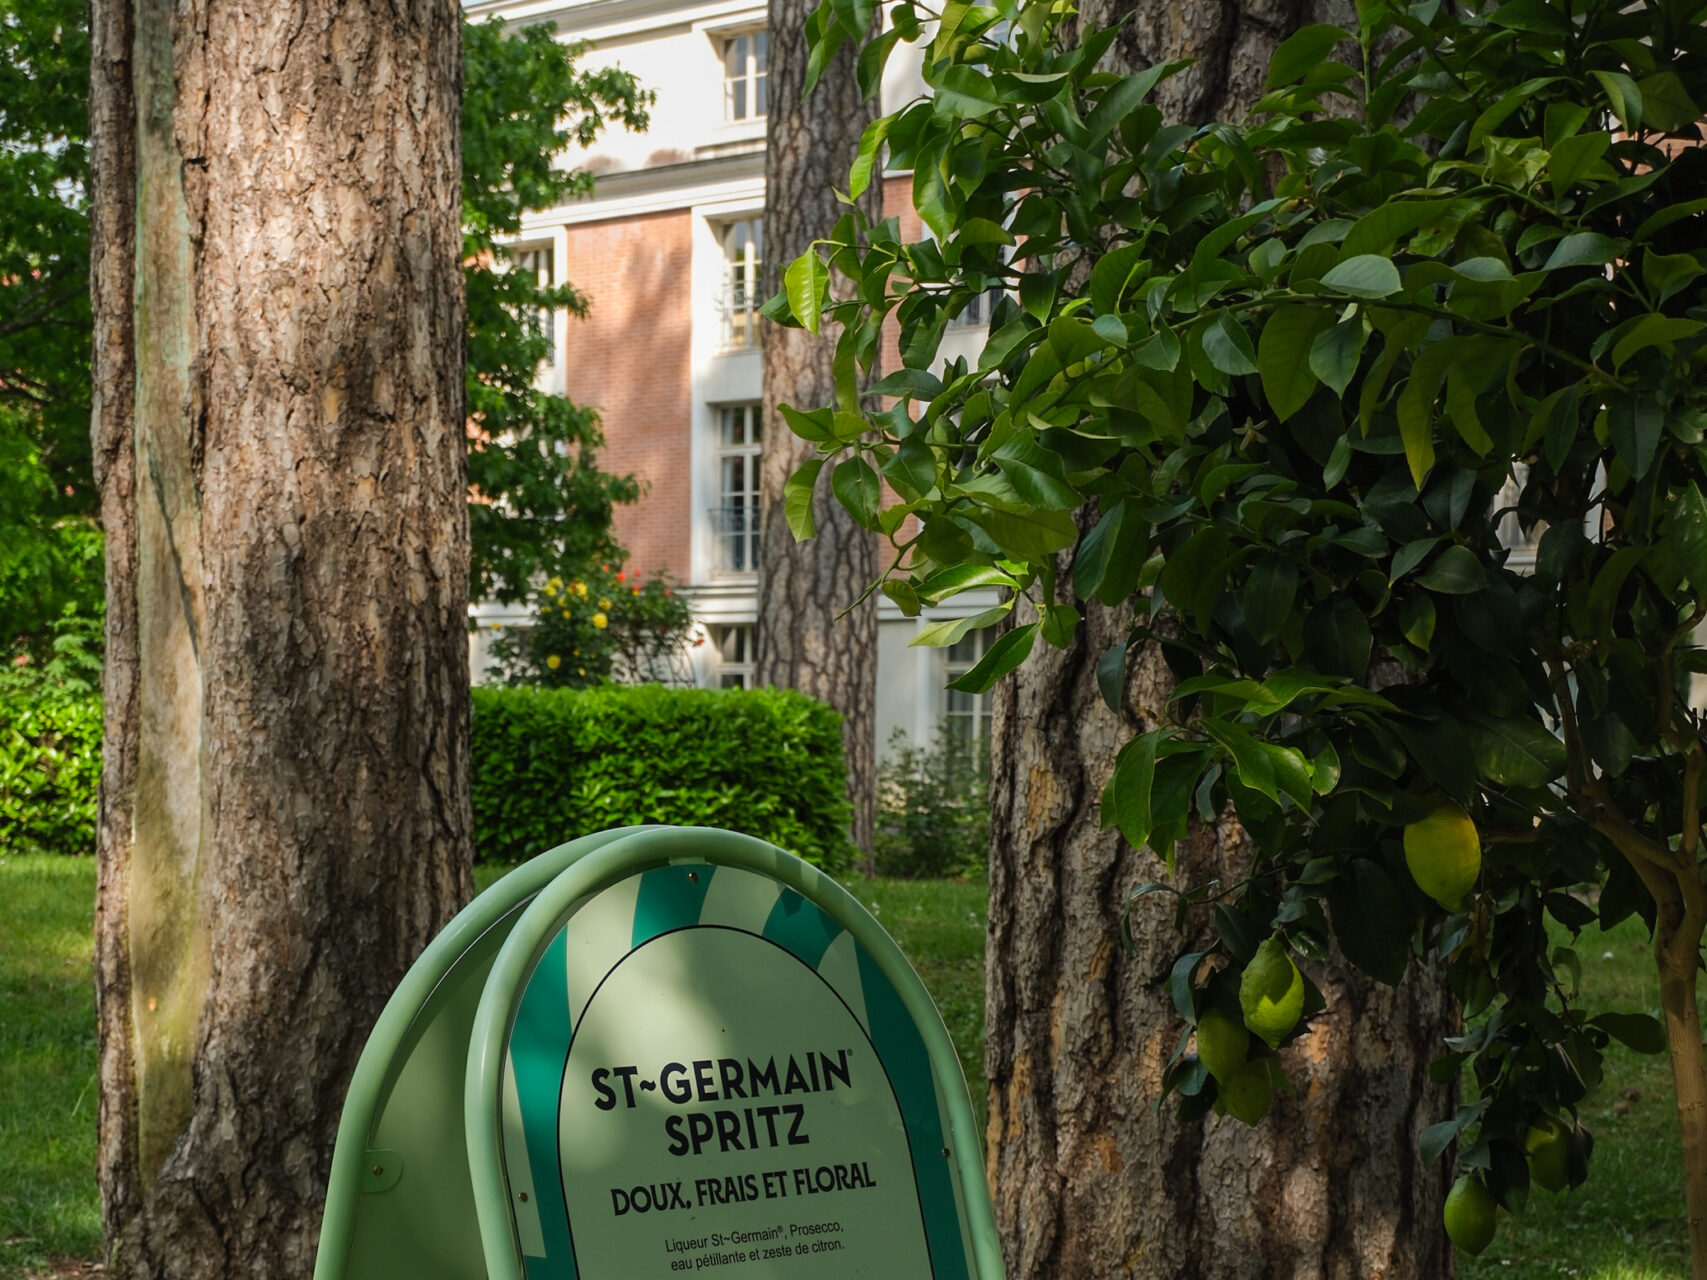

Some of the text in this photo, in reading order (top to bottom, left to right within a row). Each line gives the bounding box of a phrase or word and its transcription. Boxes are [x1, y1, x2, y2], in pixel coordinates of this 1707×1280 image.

[665, 1104, 810, 1156] SPRITZ
[610, 1162, 876, 1216] DOUX, FRAIS ET FLORAL
[665, 1237, 708, 1255] Liqueur
[789, 1220, 844, 1238] Prosecco,
[671, 1238, 845, 1272] eau pétillante et zeste de citron.
